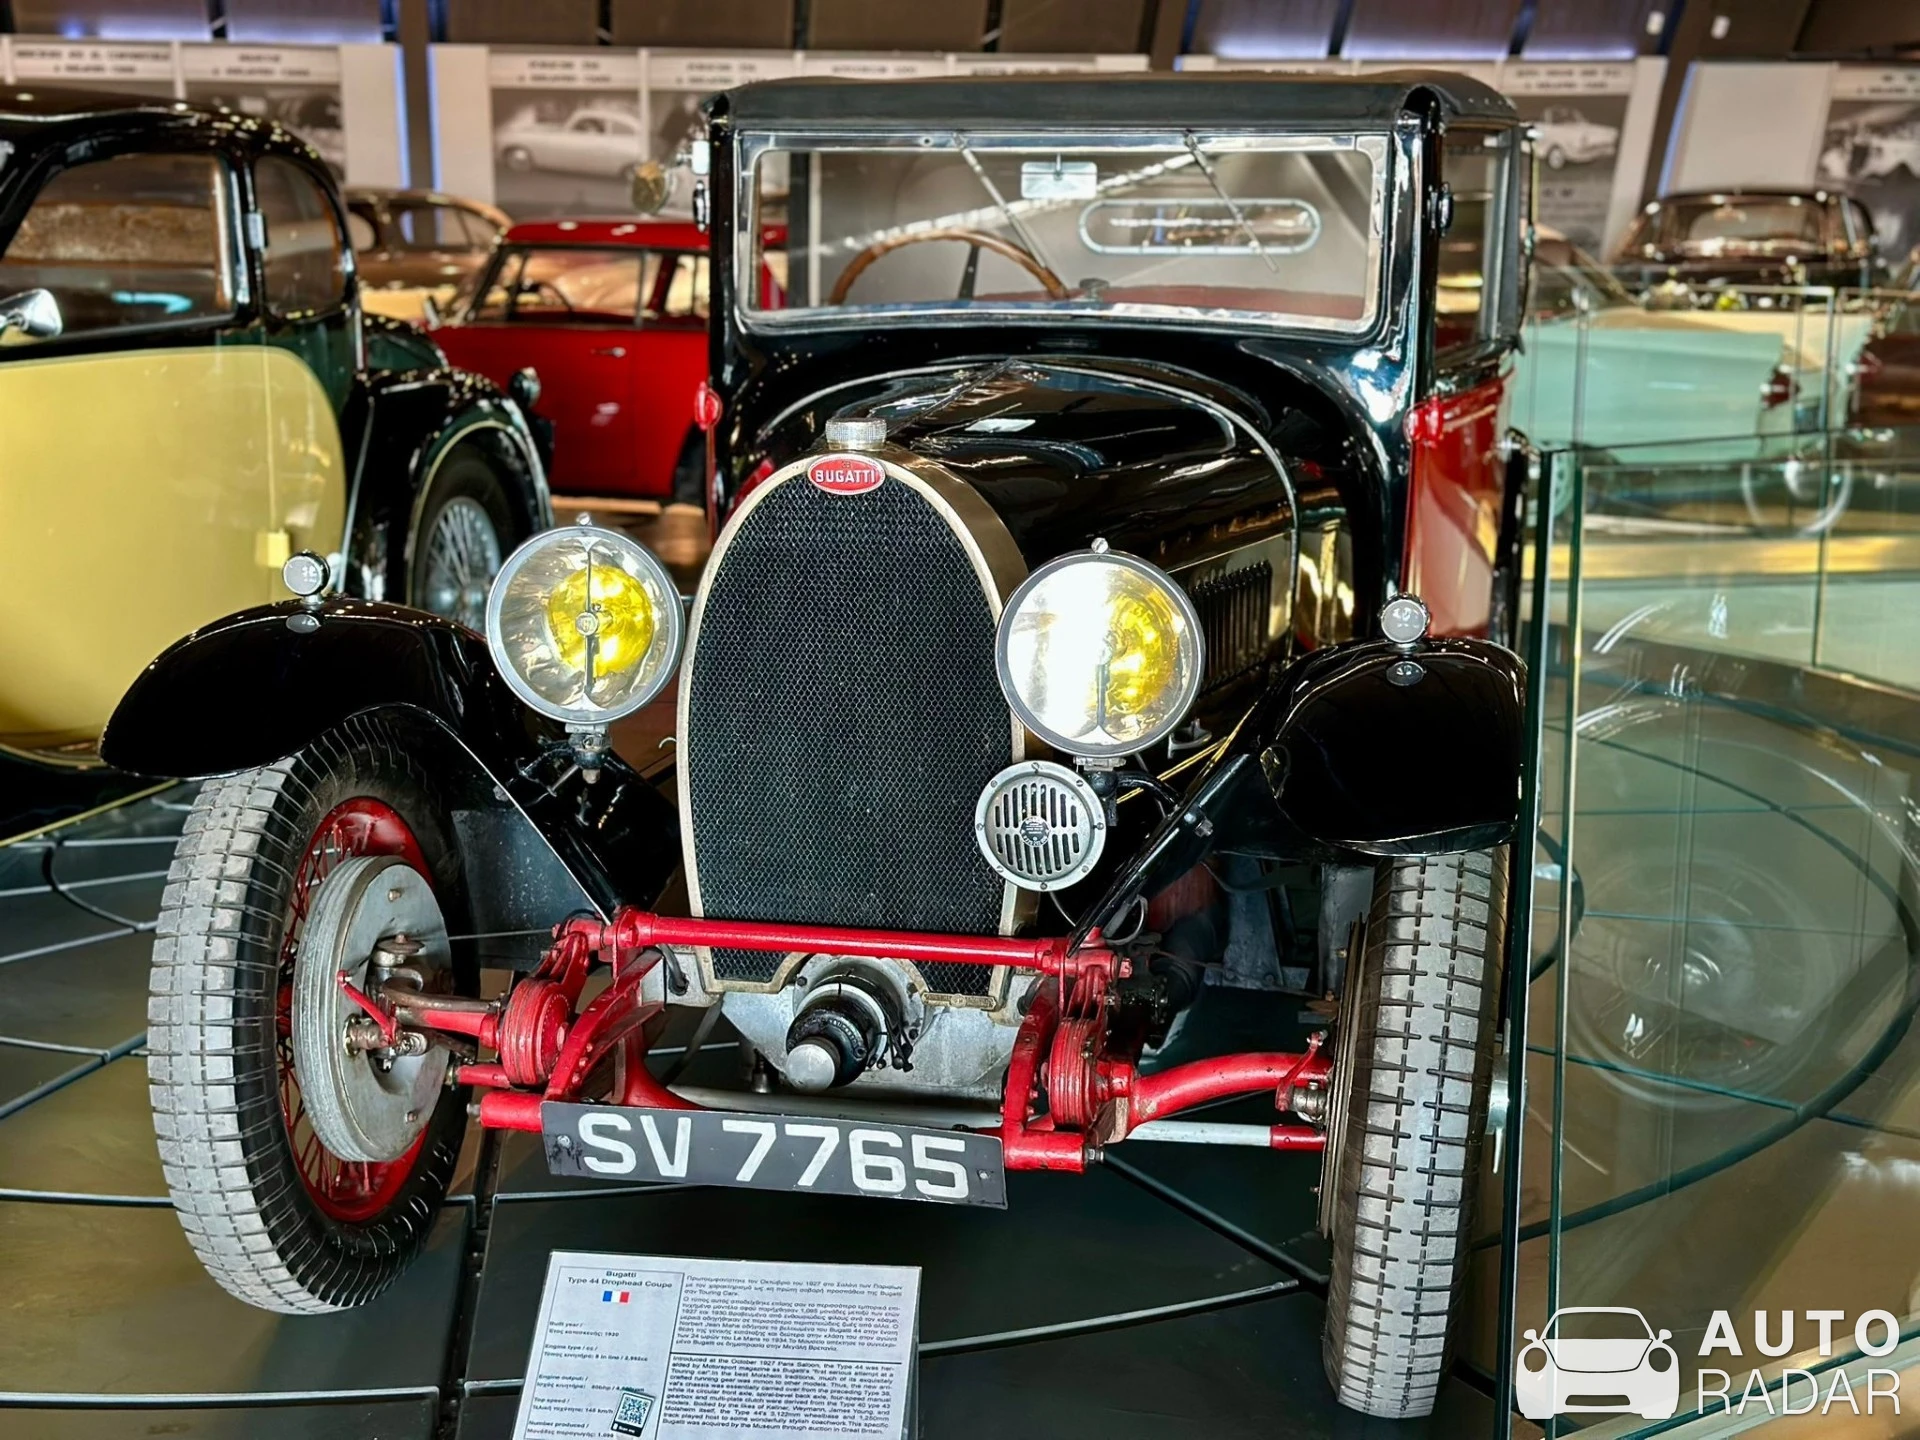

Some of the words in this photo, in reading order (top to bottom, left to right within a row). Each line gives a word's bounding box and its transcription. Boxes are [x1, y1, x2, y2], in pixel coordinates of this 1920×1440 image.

[815, 469, 876, 483] BUGATTI
[578, 1112, 692, 1178] SV
[722, 1118, 969, 1199] 7765
[605, 1270, 637, 1279] Bugatti
[601, 1278, 643, 1288] Drophead
[644, 1281, 673, 1289] Coupe
